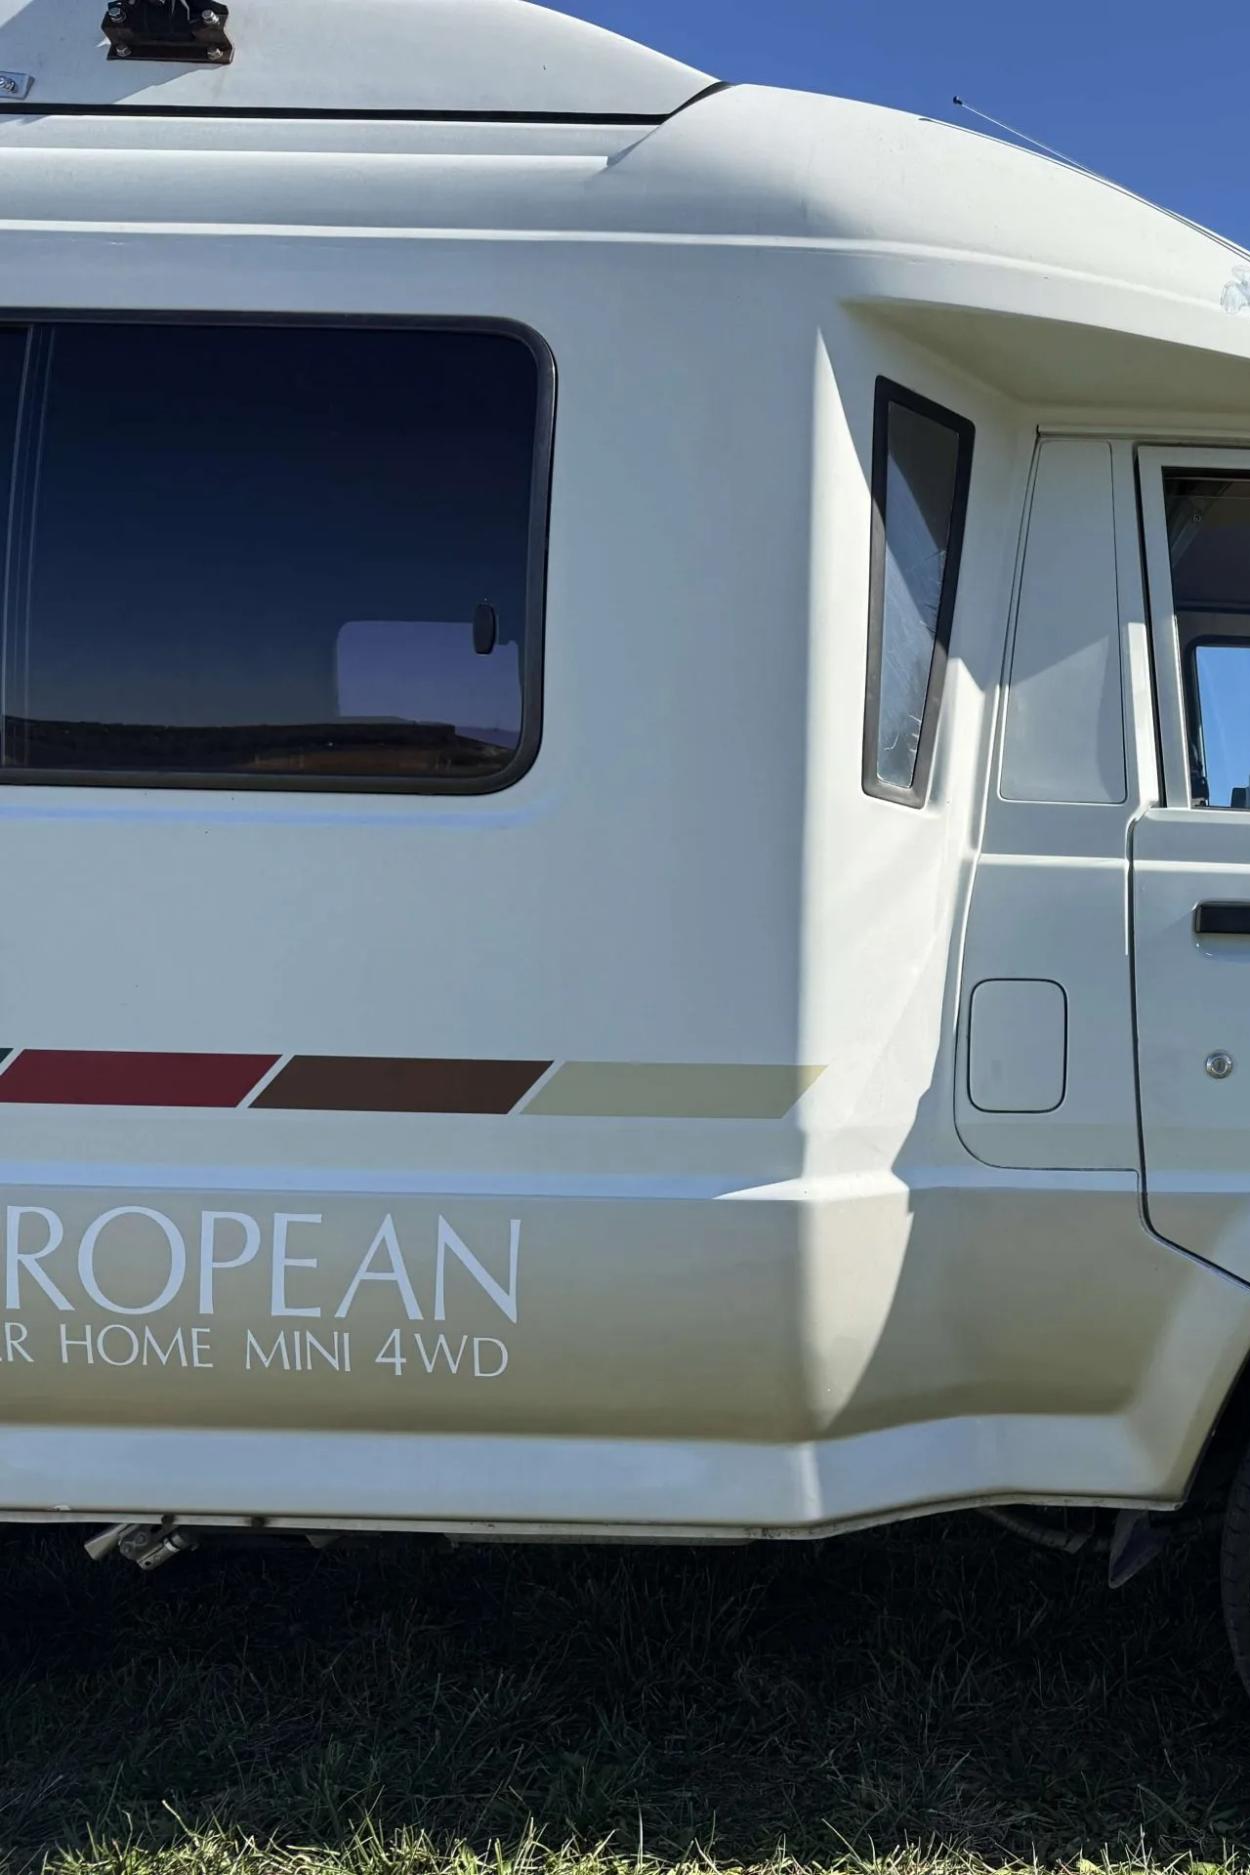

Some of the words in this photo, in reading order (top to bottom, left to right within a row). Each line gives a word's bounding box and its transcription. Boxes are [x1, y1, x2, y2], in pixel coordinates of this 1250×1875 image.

[5, 1205, 521, 1324] ROPEAN
[0, 1321, 34, 1363] R
[60, 1323, 214, 1368] HOME
[245, 1329, 351, 1372] MINI
[375, 1328, 509, 1378] 4WD
